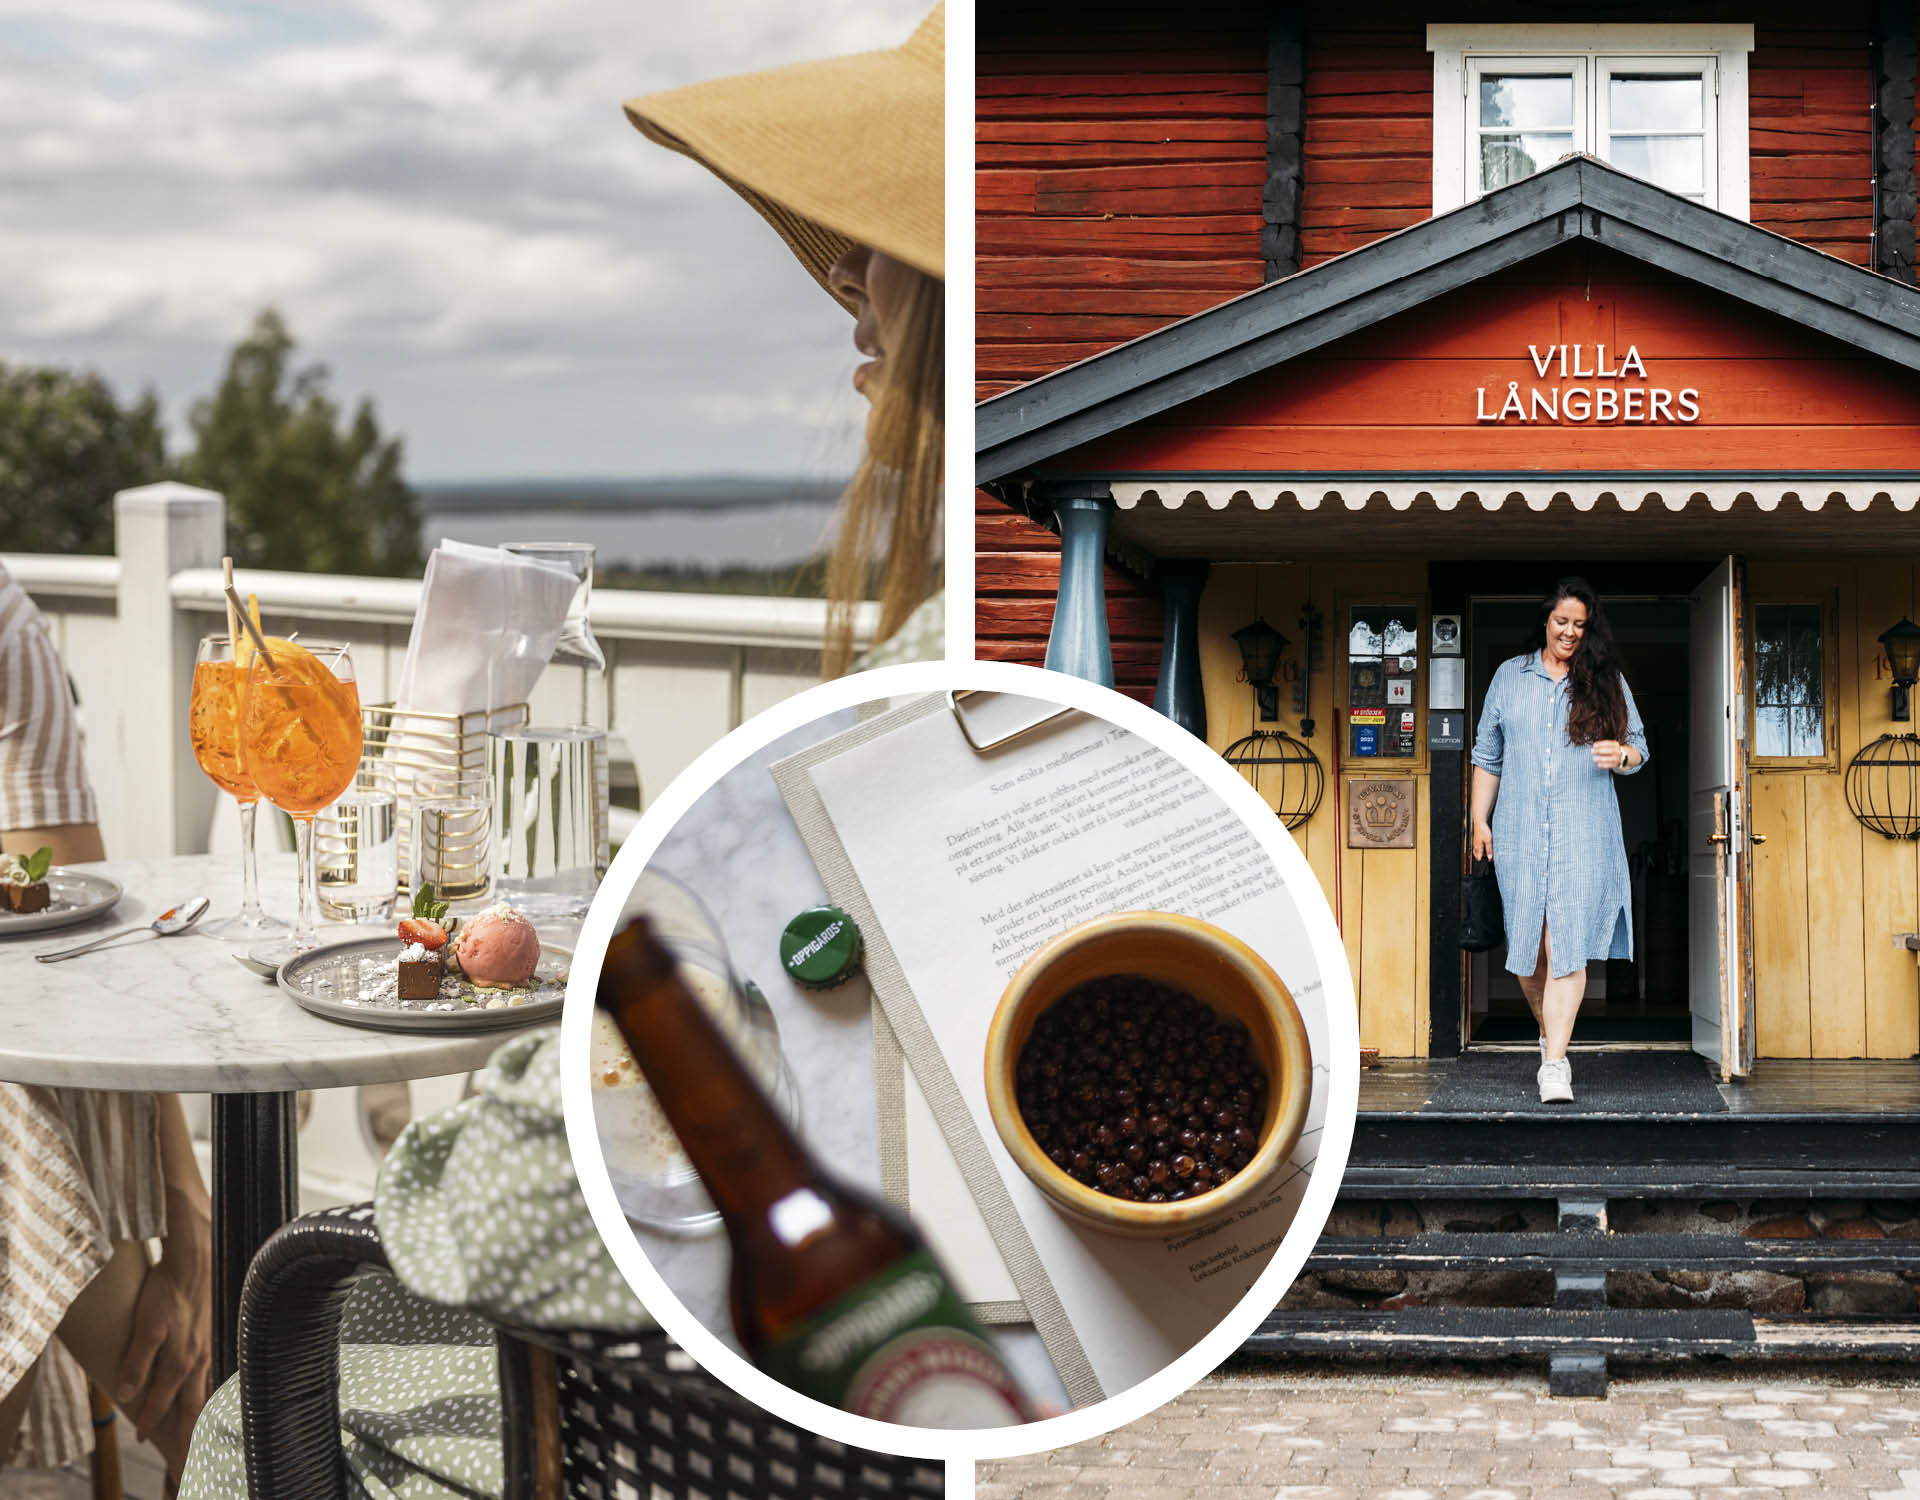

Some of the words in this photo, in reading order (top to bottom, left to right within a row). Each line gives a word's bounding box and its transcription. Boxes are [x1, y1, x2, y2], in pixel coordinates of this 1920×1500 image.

[1528, 344, 1648, 378] VILLA
[1476, 381, 1700, 421] LÅNGBERS
[982, 819, 1000, 830] har
[1046, 783, 1077, 803] jobba
[1079, 771, 1099, 786] med
[1102, 754, 1141, 776] svenska
[991, 781, 1015, 795] Som
[1017, 766, 1045, 784] stolta
[1047, 740, 1105, 770] medlemmar
[1088, 776, 1131, 798] kommer
[956, 862, 968, 876] på
[970, 855, 984, 867] ett
[1062, 813, 1076, 825] Vi
[1108, 783, 1146, 804] svenska
[1006, 854, 1020, 866] Vi
[1020, 843, 1052, 860] älskar
[1108, 800, 1144, 820] handla
[981, 908, 1006, 925] Med
[1006, 900, 1023, 914] det
[1094, 861, 1114, 873] kan
[1133, 840, 1162, 856] meny
[996, 918, 1025, 935] under
[1028, 911, 1041, 920] en
[1041, 893, 1079, 913] kortare
[1116, 861, 1149, 879] Andra
[1149, 852, 1171, 864] kan
[1170, 830, 1218, 855] försvinna
[1177, 890, 1191, 900] en
[1192, 888, 1231, 908] Sverige
[991, 937, 1011, 952] Allt
[1012, 917, 1061, 942] beroende
[1063, 909, 1074, 922] på
[1074, 904, 1092, 914] hur
[1095, 879, 1145, 904] tillgången
[1146, 870, 1165, 881] hos
[1207, 899, 1242, 918] smaker
[792, 922, 841, 966] OPPIGÅRDS
